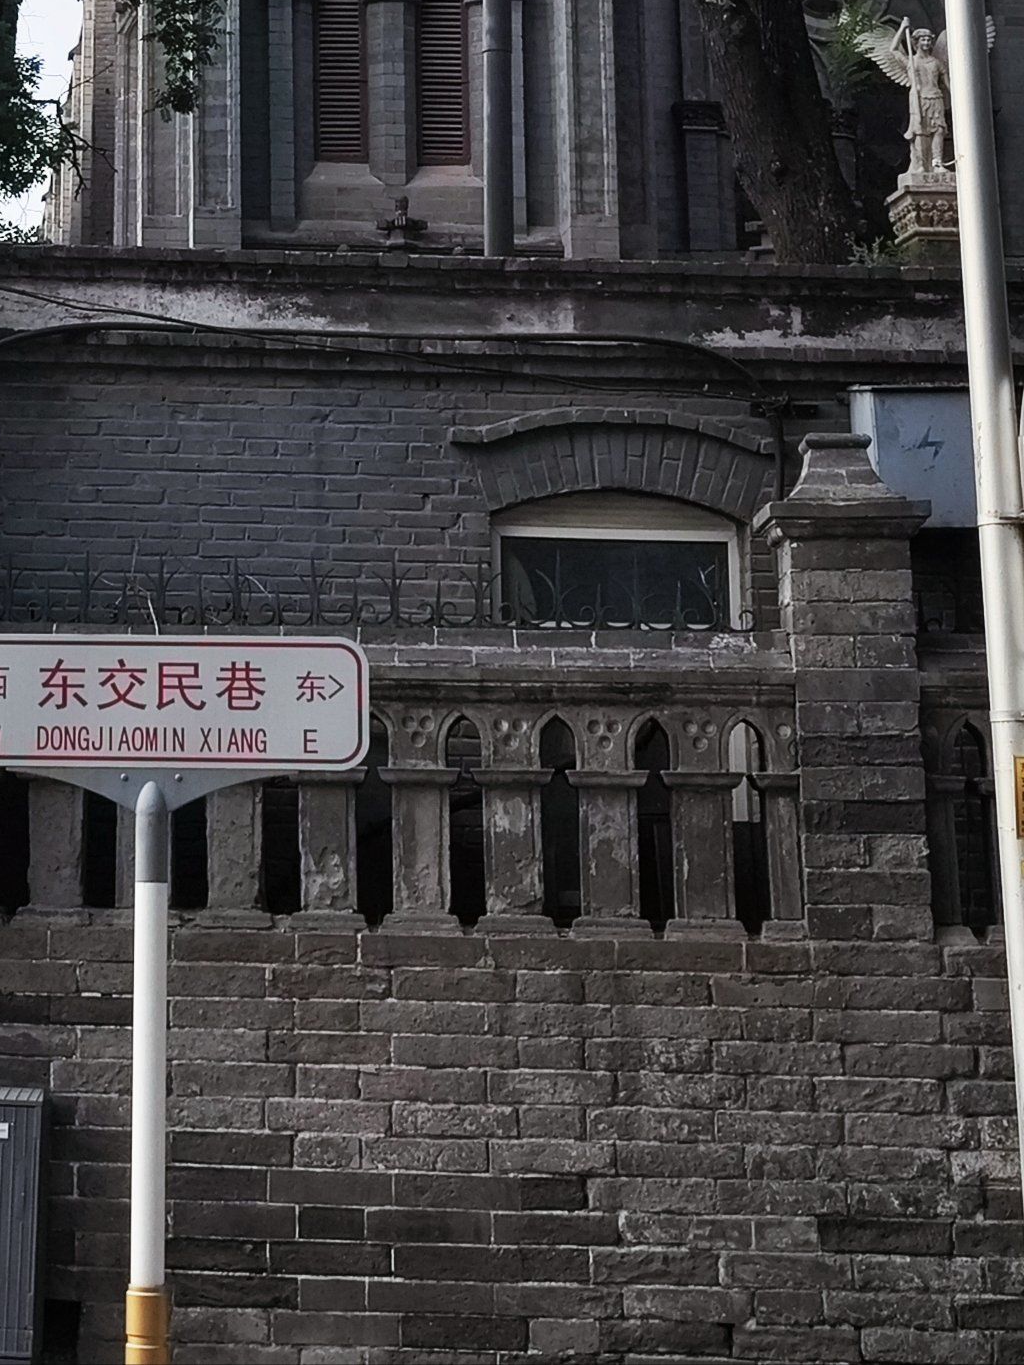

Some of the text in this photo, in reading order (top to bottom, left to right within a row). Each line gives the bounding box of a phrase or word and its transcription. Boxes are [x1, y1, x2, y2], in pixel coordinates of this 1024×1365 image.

[38, 658, 267, 711] 东交民巷
[295, 670, 327, 703] 东
[36, 725, 268, 754] DONGJIAOMIN XIANG
[302, 729, 319, 754] E
